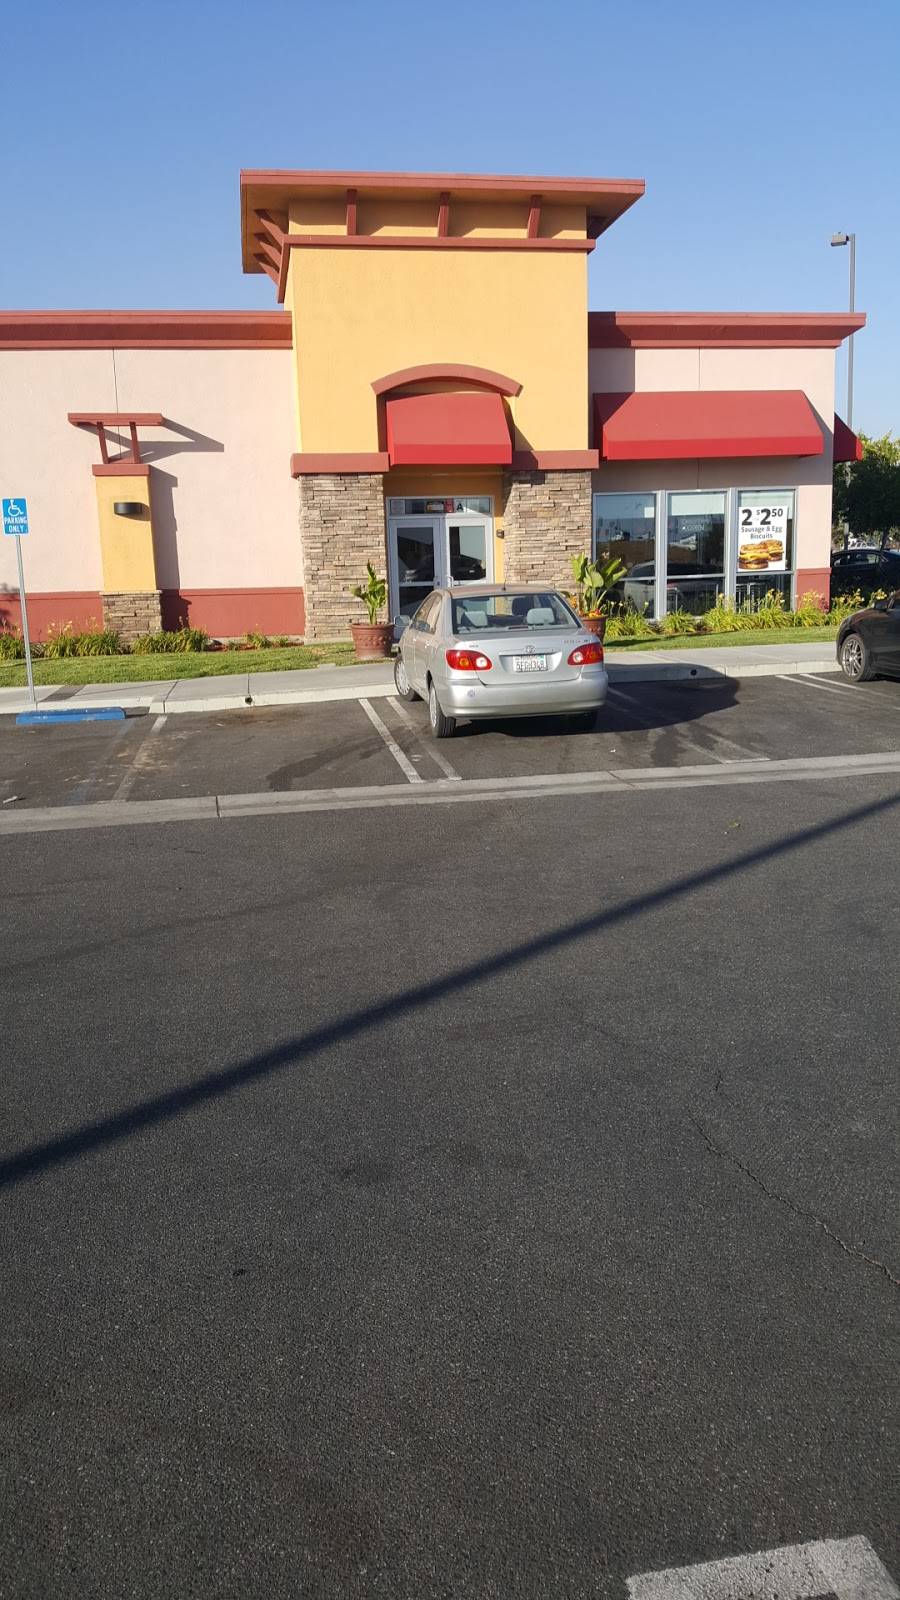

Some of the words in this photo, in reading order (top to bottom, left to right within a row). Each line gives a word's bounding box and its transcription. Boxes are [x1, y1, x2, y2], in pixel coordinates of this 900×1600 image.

[4, 516, 28, 525] PARKING
[741, 508, 752, 525] 2
[8, 525, 24, 533] ONLY
